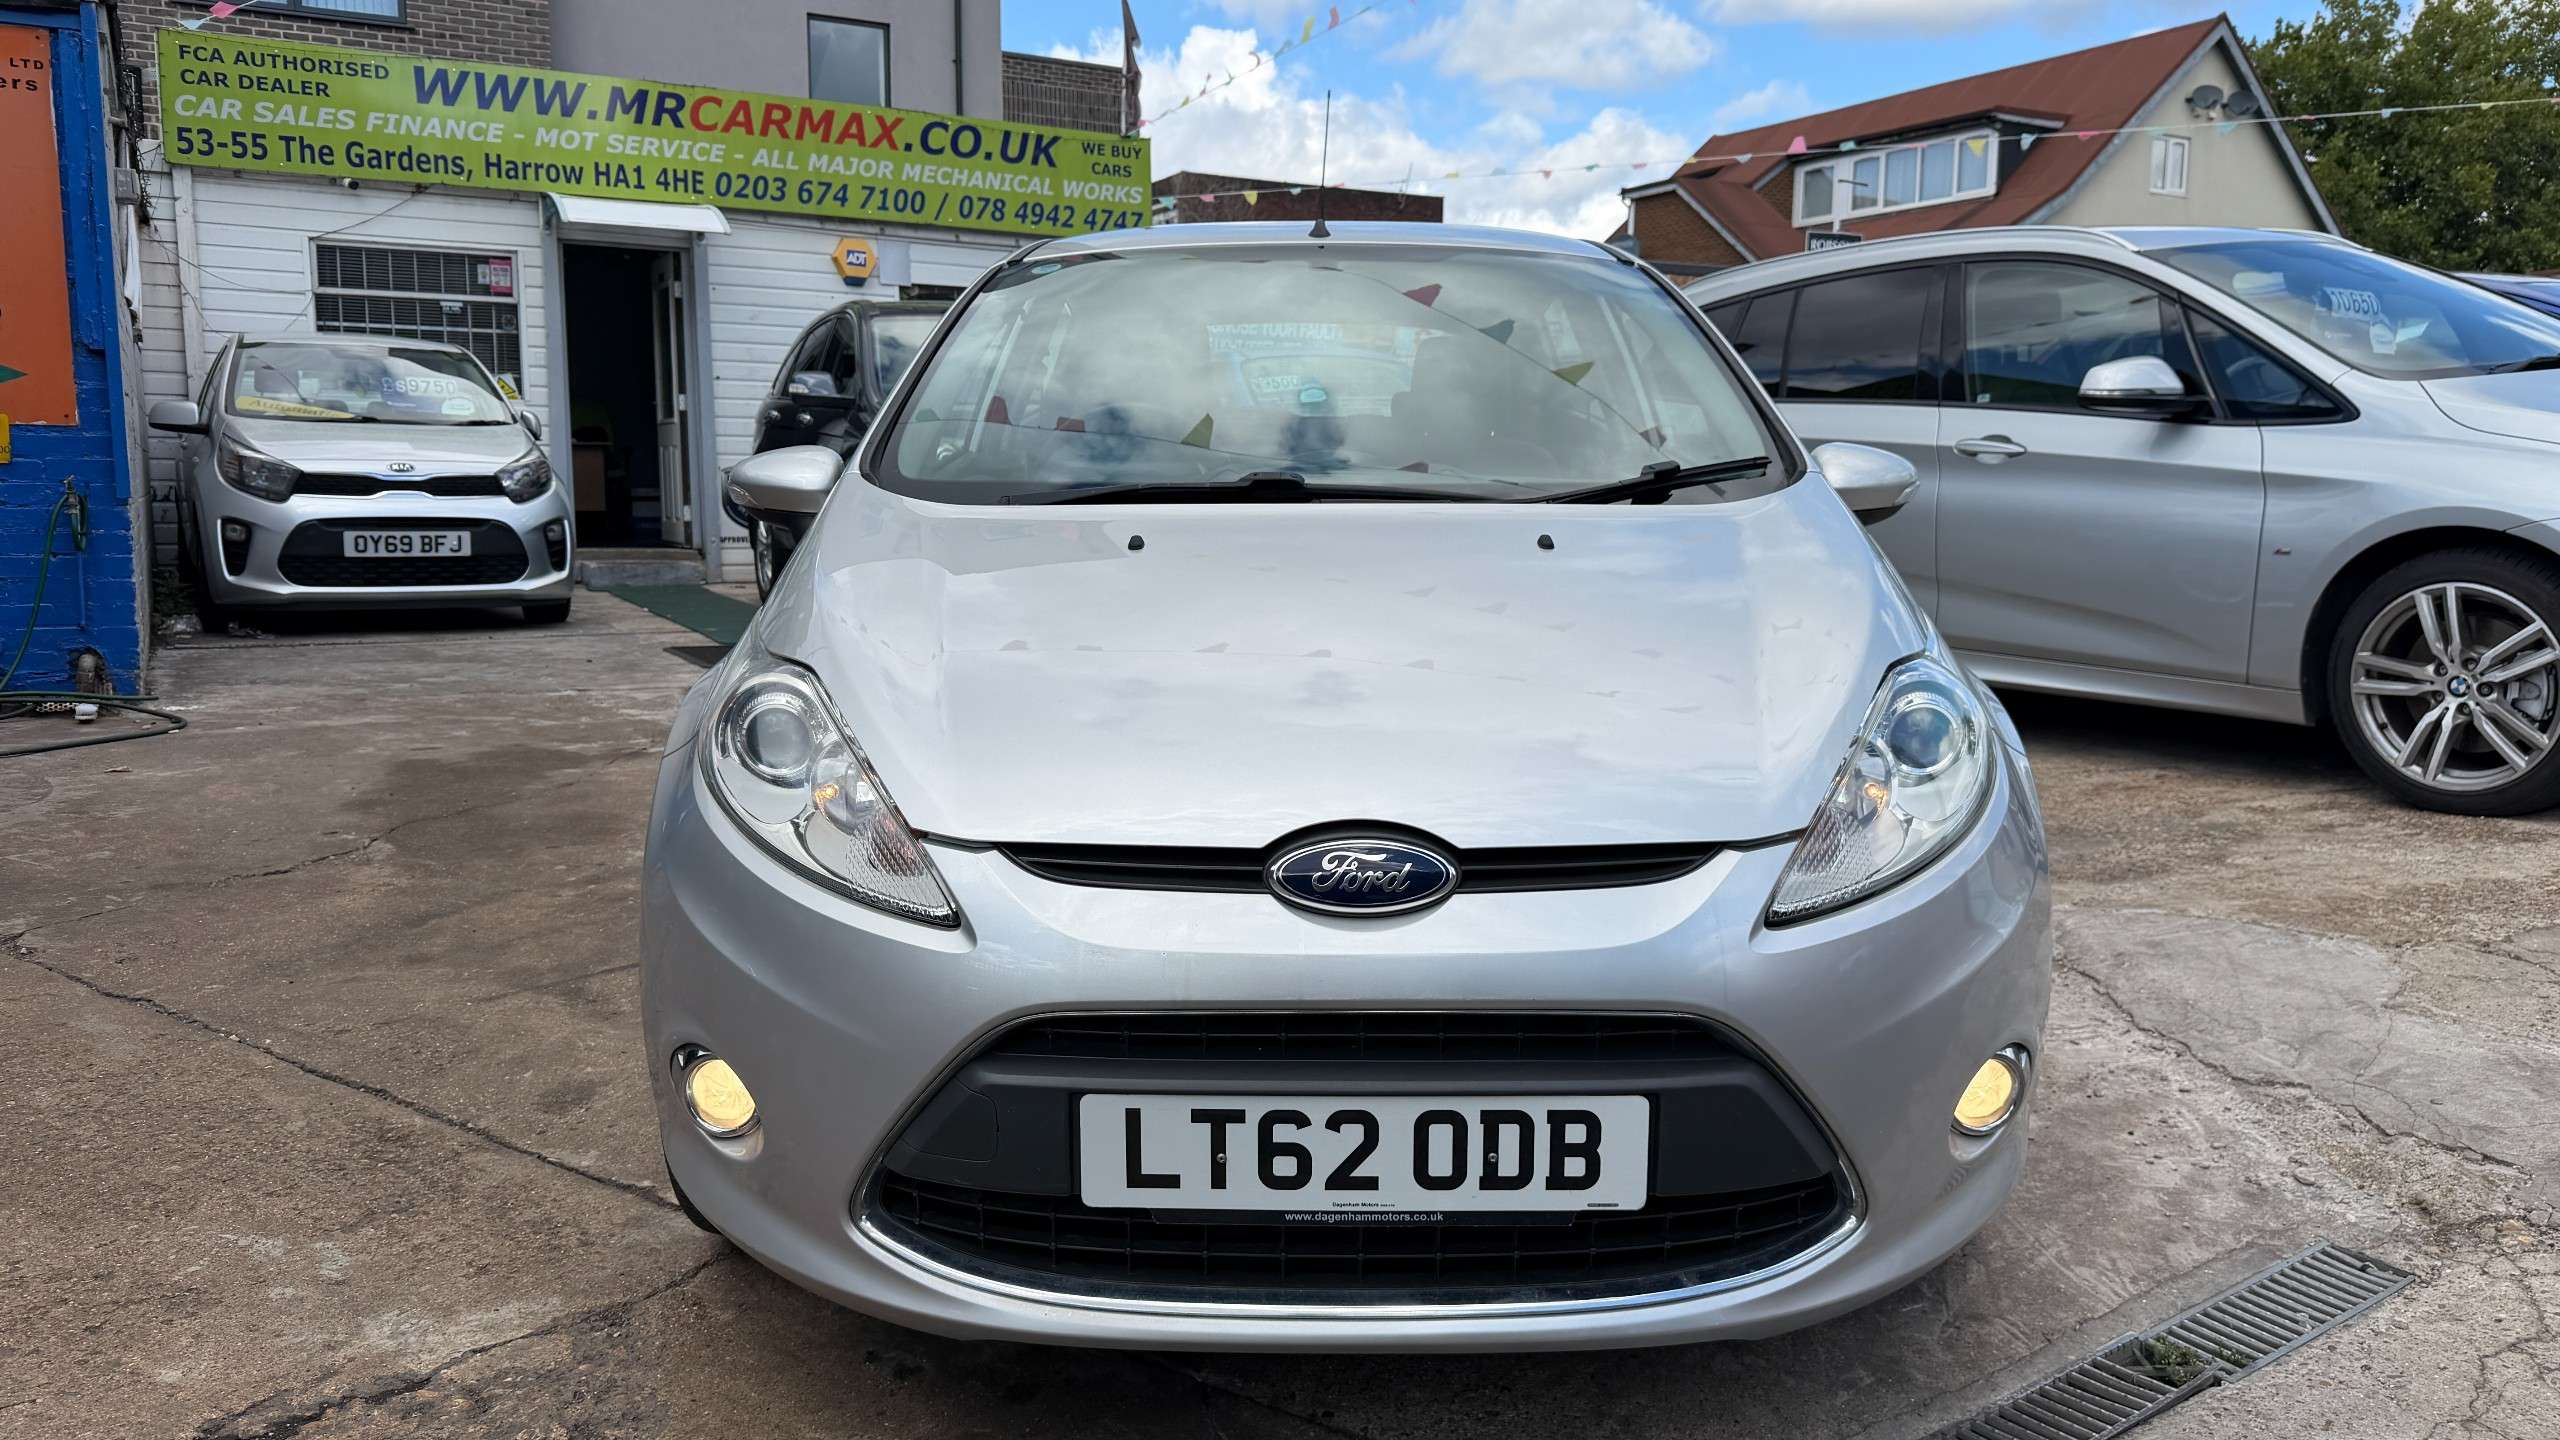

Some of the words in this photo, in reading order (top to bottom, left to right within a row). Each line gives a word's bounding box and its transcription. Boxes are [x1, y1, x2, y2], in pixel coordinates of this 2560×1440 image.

[9, 57, 44, 70] LTD
[178, 44, 225, 64] FCA
[233, 50, 390, 80] AUTHORISED
[180, 68, 230, 89] CAR
[238, 74, 331, 98] DEALER
[413, 64, 1063, 169] WWW.MRCARMAX.CO.UK
[174, 94, 242, 121] CAR
[253, 102, 356, 130] SALES
[366, 111, 504, 143] FINANCE
[535, 126, 599, 151] MOT
[606, 134, 726, 163] SERVICE
[752, 148, 799, 170] ALL
[808, 153, 894, 180] MAJOR
[901, 163, 1054, 196] MECHANICAL
[1063, 179, 1143, 204] WORKS
[1082, 141, 1105, 157] WE
[1111, 144, 1143, 160] BUY
[176, 126, 268, 161] 53-55
[278, 134, 334, 166] The
[345, 140, 473, 182] Gardens,
[484, 152, 584, 185] Harrow
[594, 161, 646, 190] HA1
[655, 167, 705, 195] 4HE
[715, 171, 787, 202] 0203
[798, 179, 849, 208] 674
[860, 185, 926, 214] 7100
[959, 195, 1006, 222] 078
[1014, 201, 1075, 229] 4942
[1084, 208, 1144, 232] 4747
[1091, 162, 1133, 178] CARS
[847, 252, 868, 265] ADT
[354, 535, 413, 553] OY69
[419, 535, 462, 553] BFJ
[1311, 851, 1413, 893] Ford
[1125, 1107, 1380, 1191] LT62
[1412, 1109, 1602, 1191] ODB
[1284, 1212, 1444, 1223] www.dagenhammotors.co.uk
